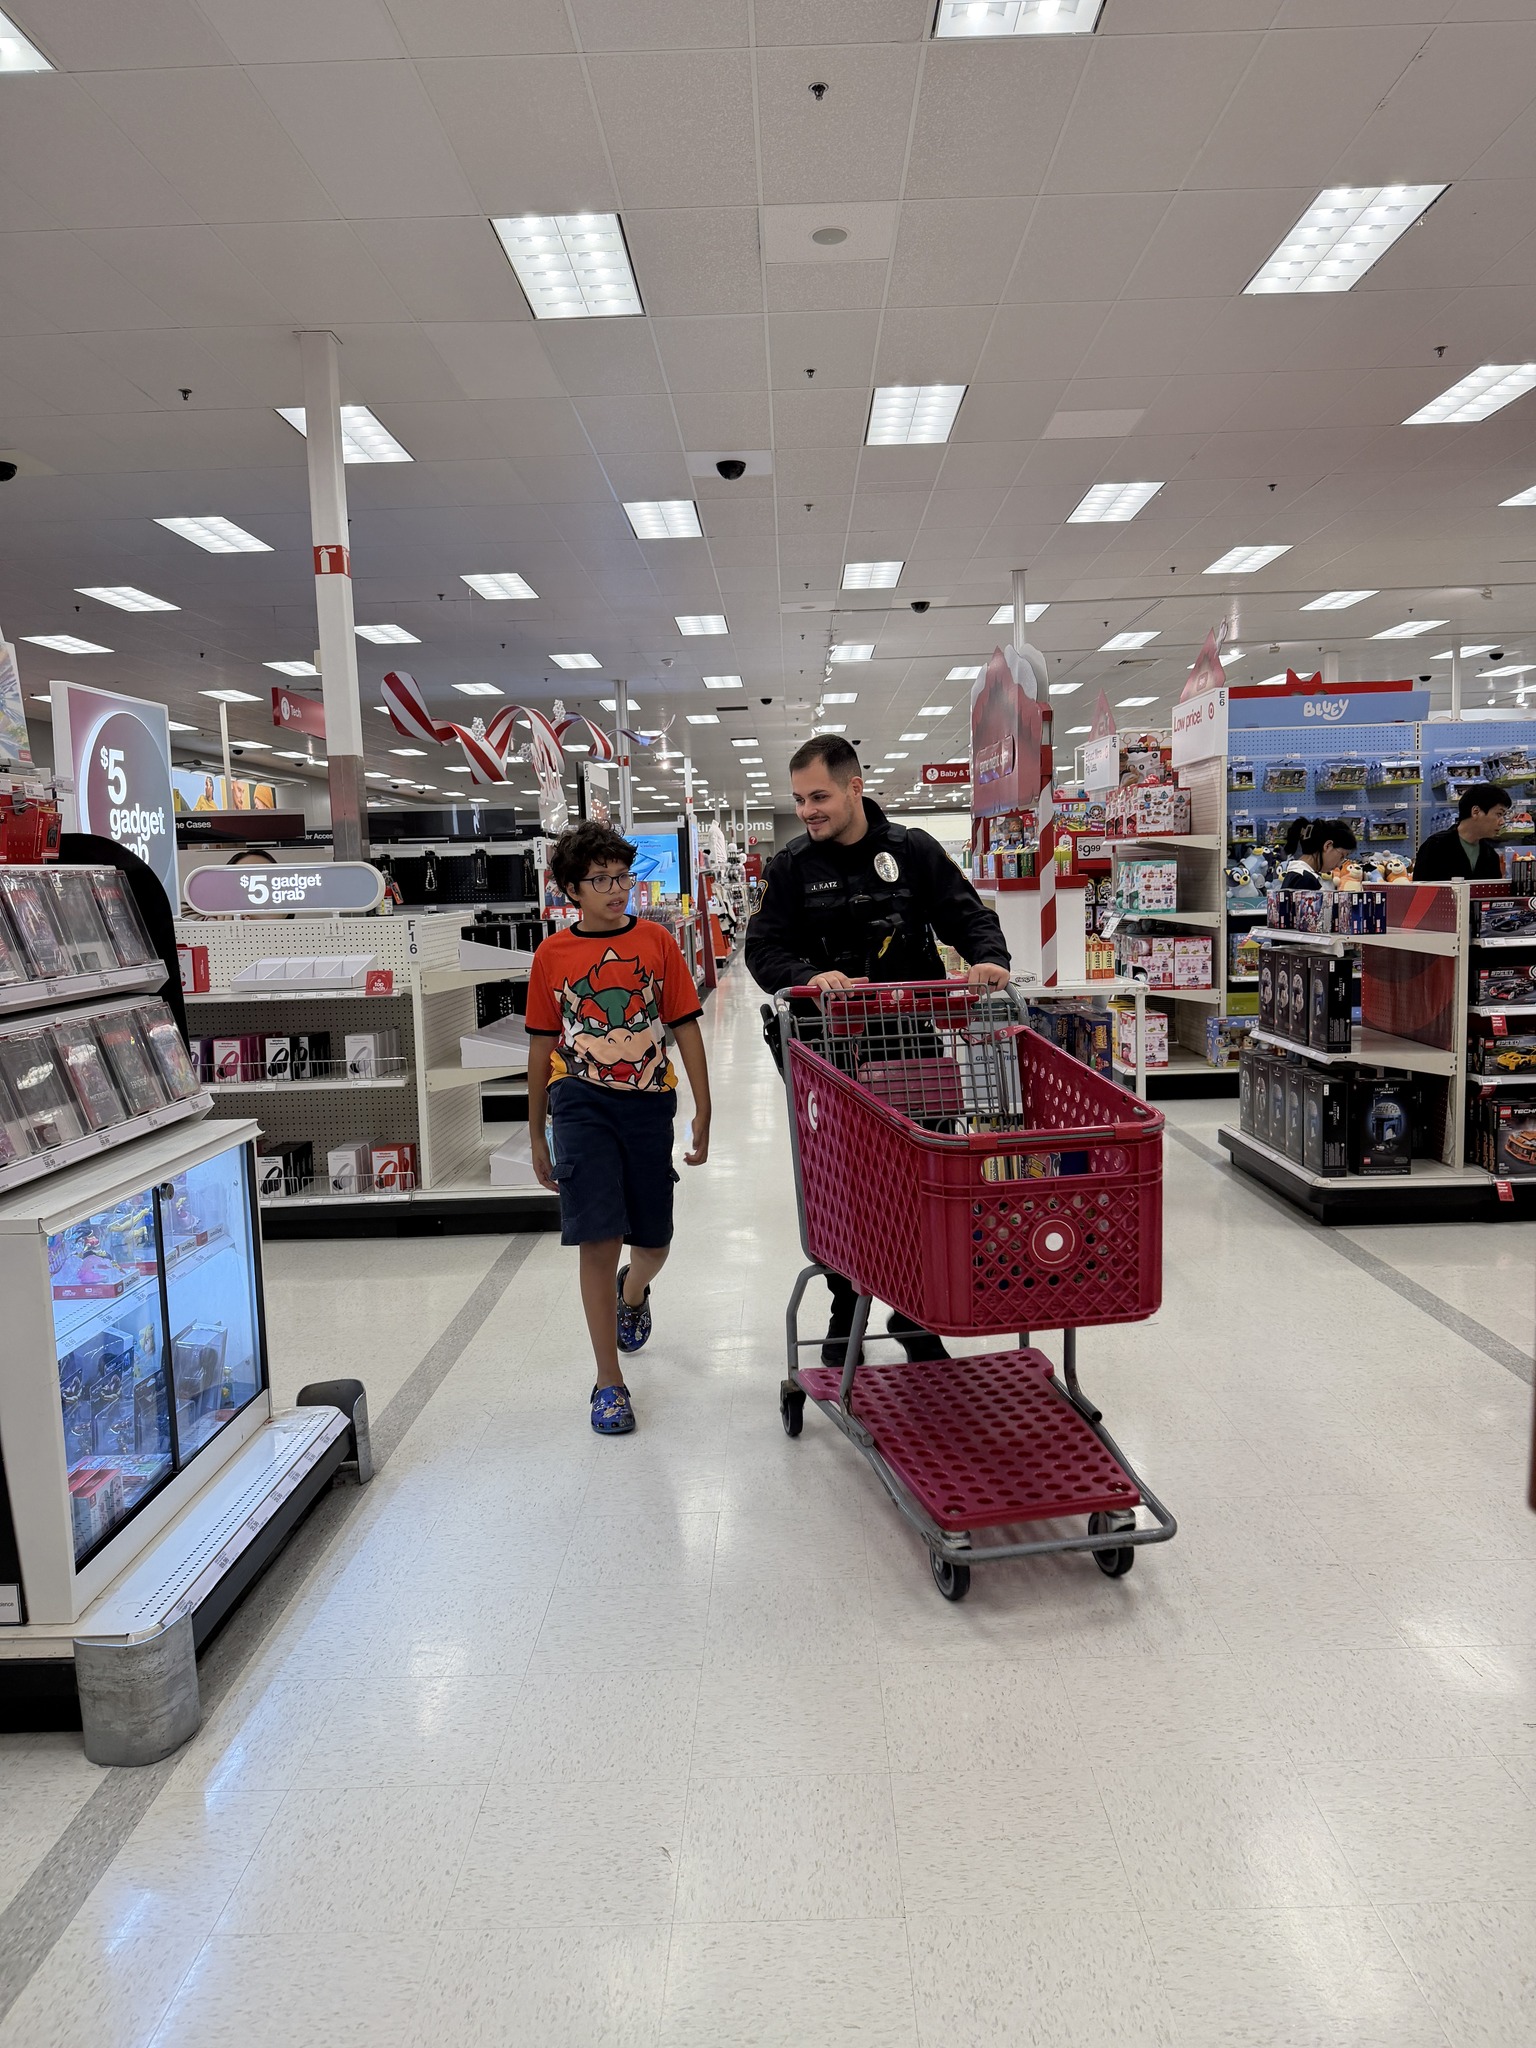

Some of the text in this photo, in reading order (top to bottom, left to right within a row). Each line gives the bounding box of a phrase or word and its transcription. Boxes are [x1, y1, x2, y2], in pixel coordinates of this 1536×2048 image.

[290, 704, 302, 719] Tech
[1303, 699, 1349, 720] BLUEY
[1174, 705, 1203, 733] Low price!
[100, 746, 127, 805] $5
[940, 770, 958, 778] Baby
[1062, 803, 1087, 812] LIFE
[110, 803, 165, 842] gadget
[186, 820, 212, 829] Cases
[314, 832, 333, 840] Acces
[271, 873, 322, 888] gadget
[819, 881, 838, 889] KATZ
[239, 874, 270, 904] $5
[272, 887, 305, 904] grab
[1245, 1019, 1259, 1028] BLU
